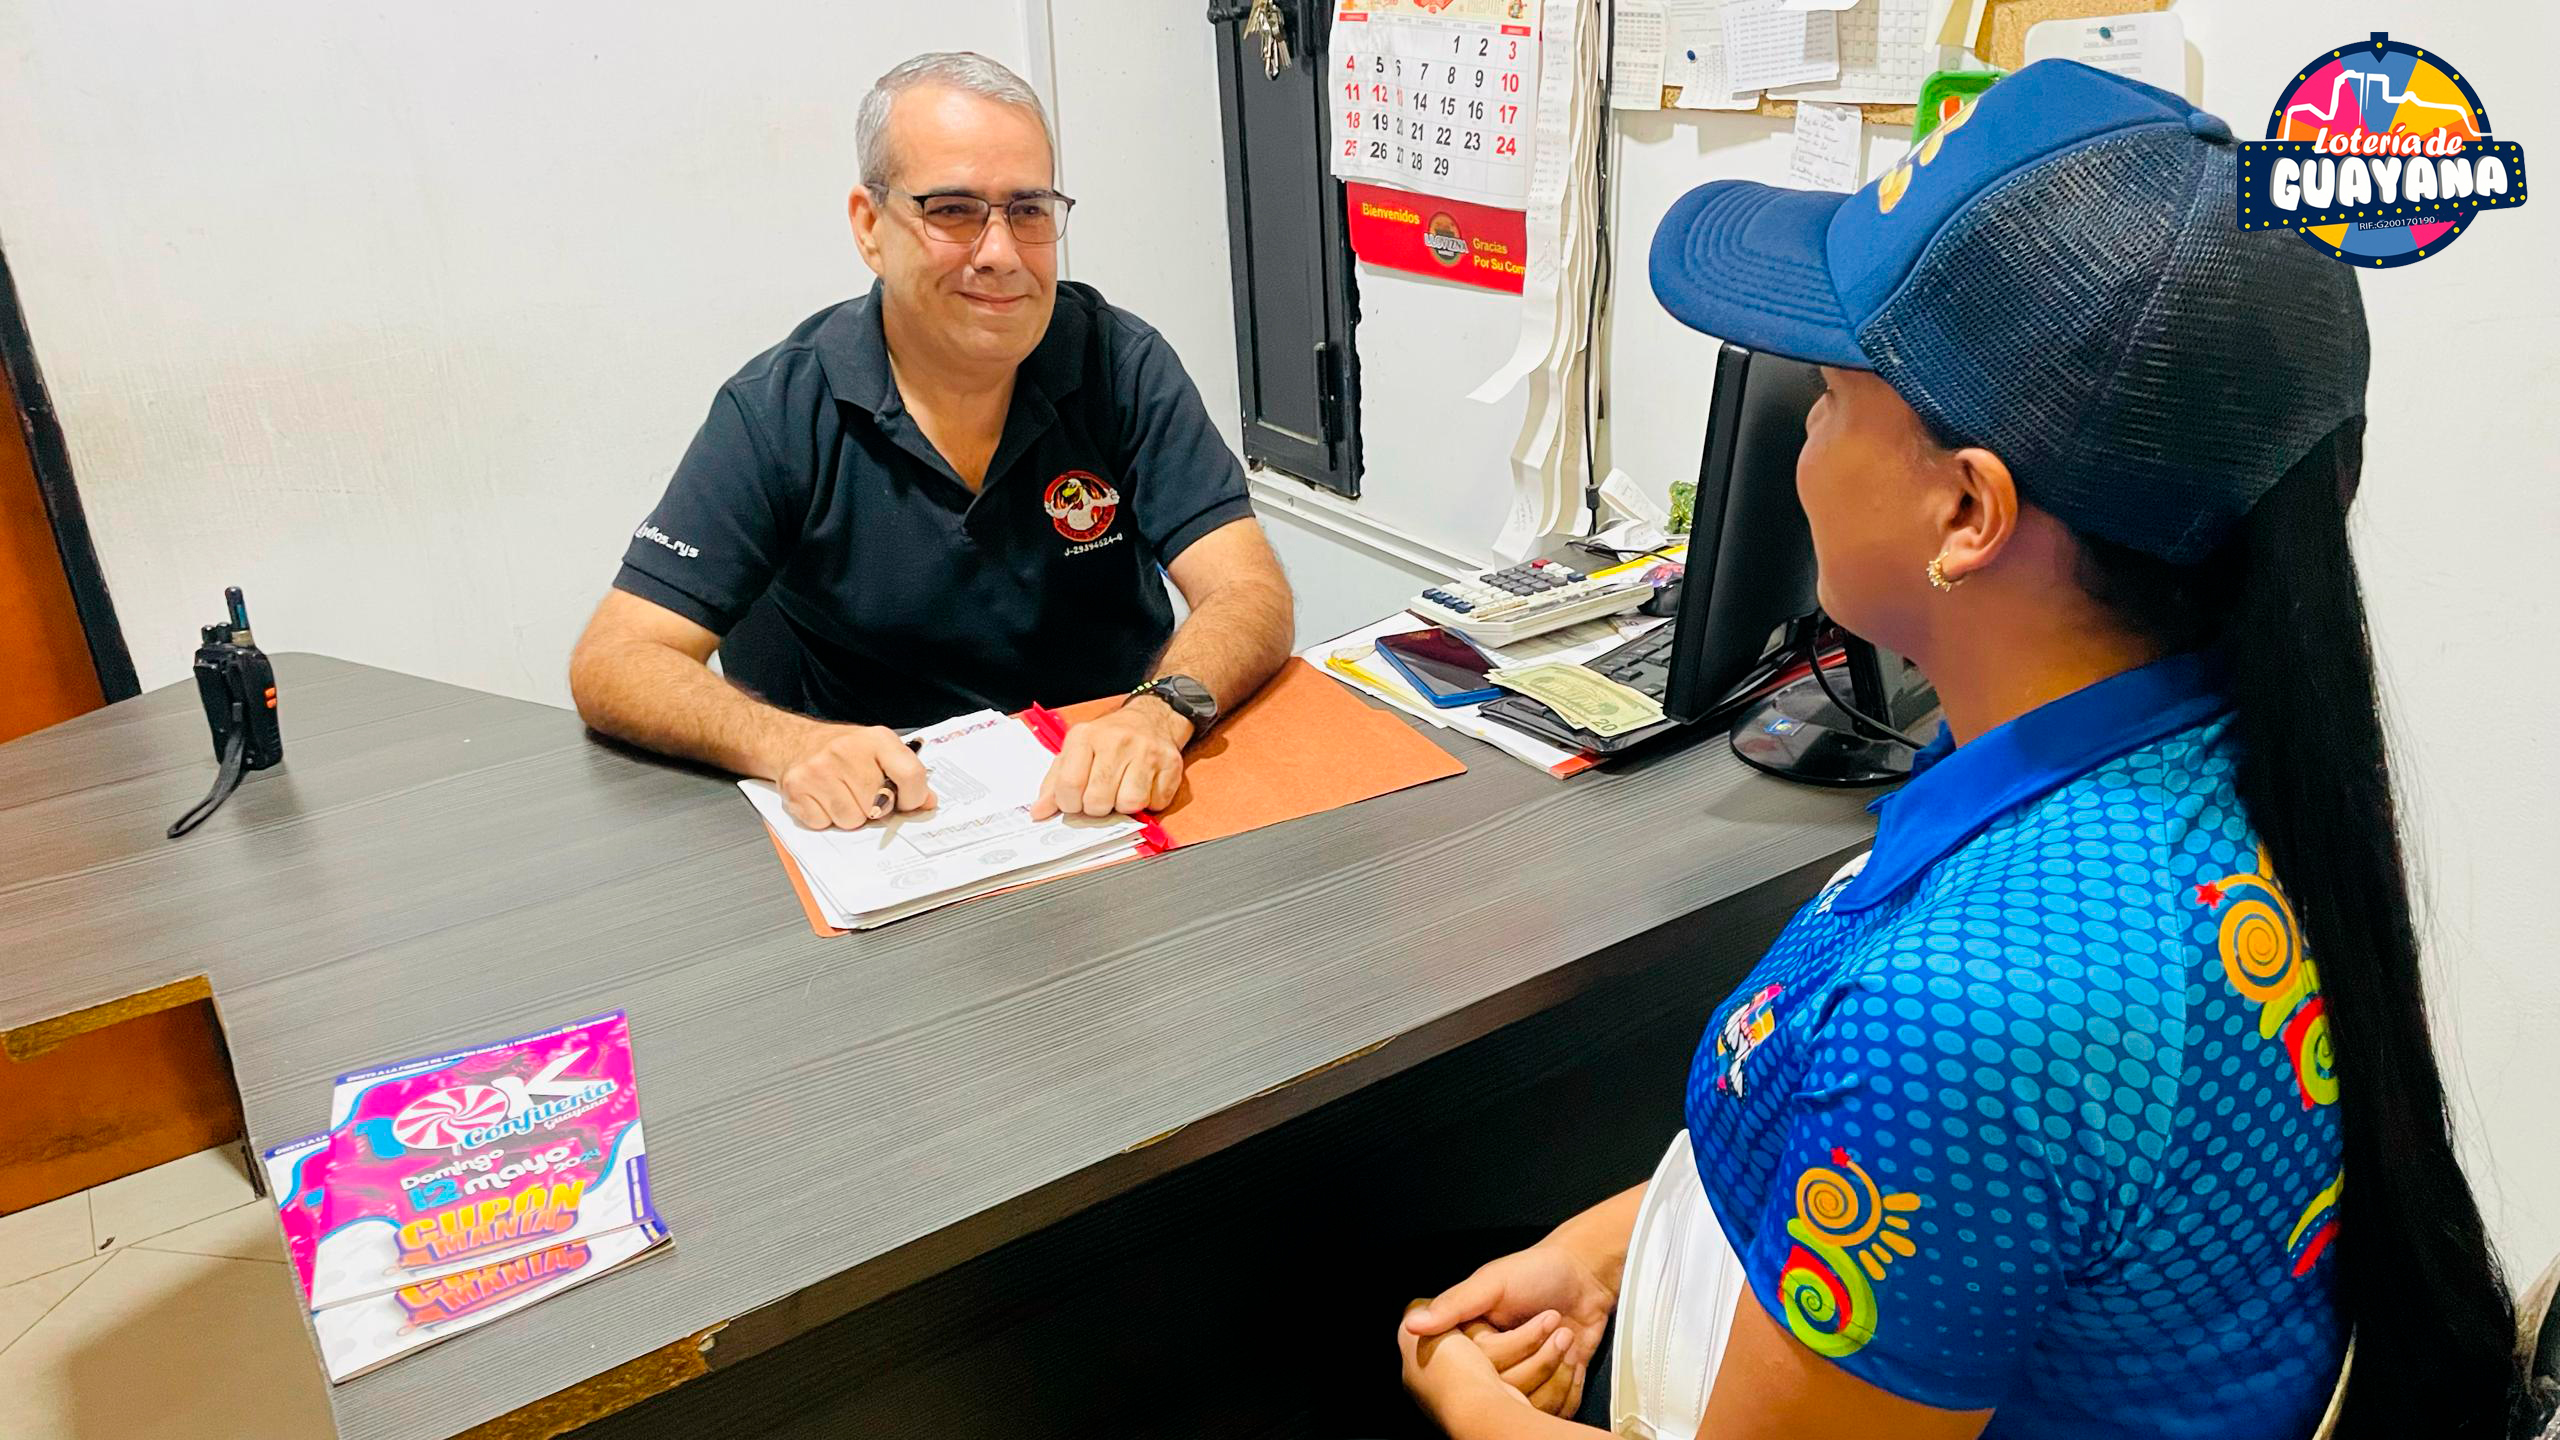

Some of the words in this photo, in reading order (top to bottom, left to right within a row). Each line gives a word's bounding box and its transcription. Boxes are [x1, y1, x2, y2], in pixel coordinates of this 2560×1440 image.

[1454, 35, 1461, 54] 1
[1479, 38, 1488, 57] 2
[1508, 41, 1517, 60] 3
[1346, 55, 1355, 72] 4
[1376, 56, 1384, 73] 5
[1421, 63, 1429, 81] 7
[1447, 66, 1456, 84] 8
[1475, 70, 1484, 88] 9
[1501, 73, 1519, 93] 10
[1345, 83, 1360, 101] 11
[1372, 84, 1388, 103] 12
[1413, 92, 1428, 111] 14
[1440, 96, 1456, 115] 15
[1468, 100, 1484, 120] 16
[1499, 105, 1518, 124] 17
[1346, 112, 1360, 129] 18
[1372, 113, 1388, 131] 19
[1411, 122, 1424, 141] 21
[1436, 127, 1451, 146] 22
[1464, 131, 1481, 151] 23
[1496, 136, 1516, 156] 24
[1370, 142, 1388, 160] 26
[1412, 152, 1423, 171] 28
[1434, 157, 1449, 176] 29
[1362, 202, 1421, 225] Bienvenidos
[1473, 237, 1508, 255] Gracias
[1474, 255, 1489, 269] Por
[1491, 258, 1504, 271] Su
[1592, 718, 1618, 732] 20
[463, 1146, 570, 1195] mayo
